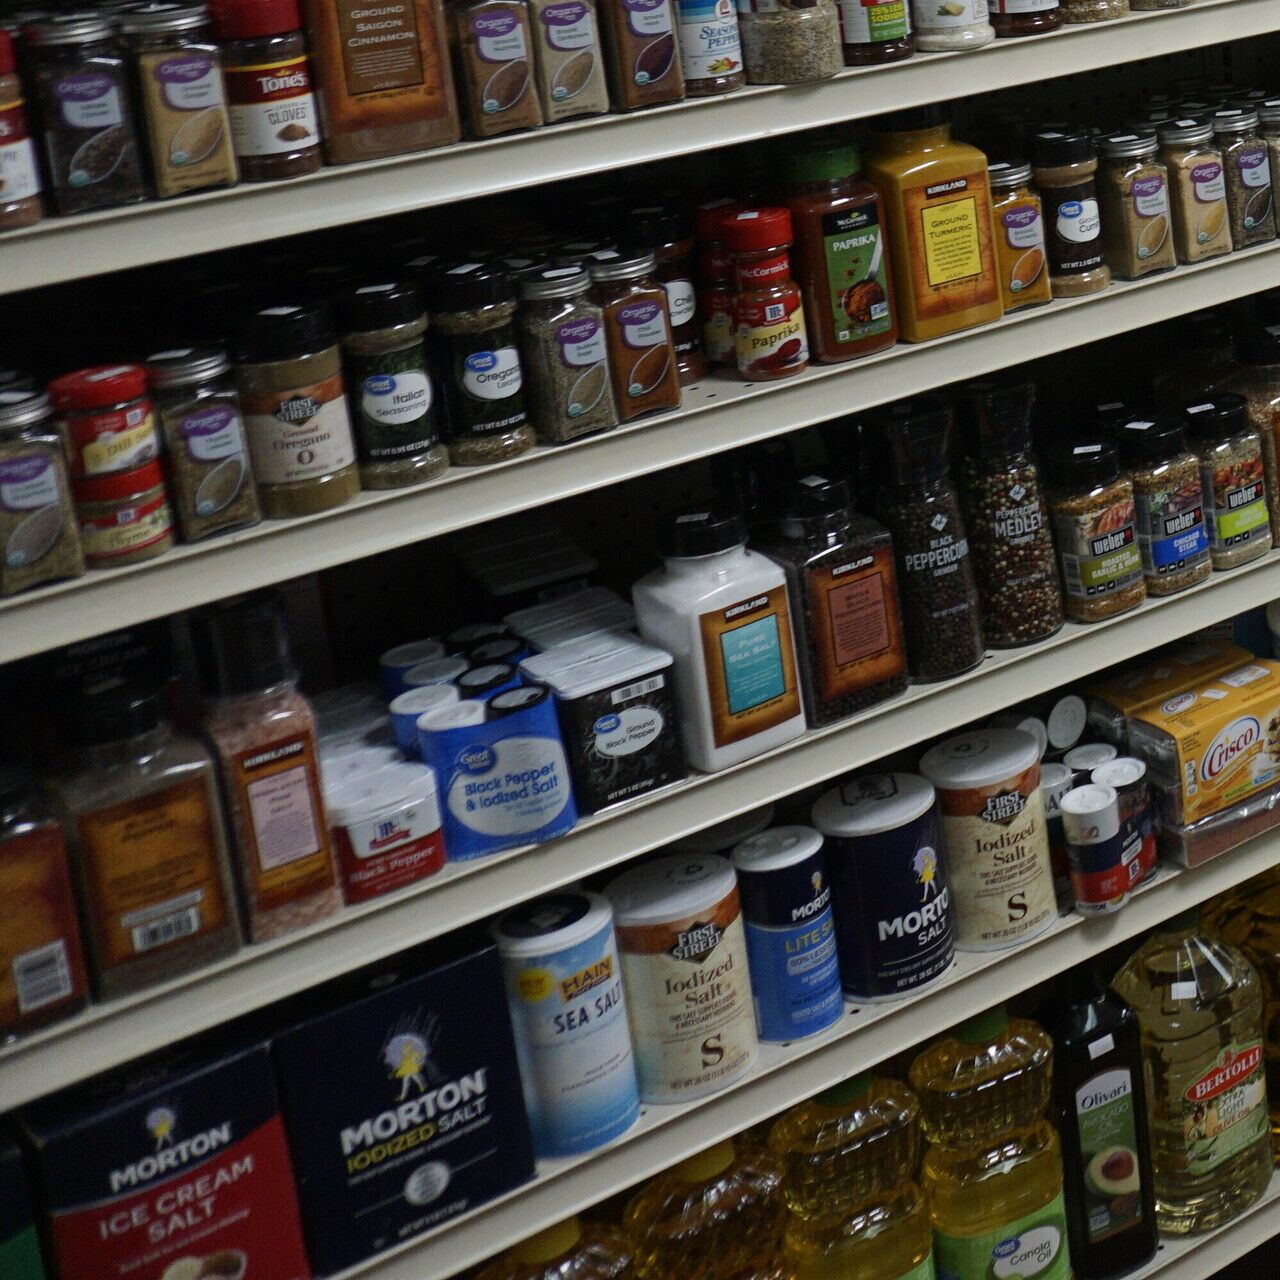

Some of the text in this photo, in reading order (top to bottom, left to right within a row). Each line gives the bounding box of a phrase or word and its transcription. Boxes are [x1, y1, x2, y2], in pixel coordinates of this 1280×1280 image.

[351, 3, 404, 21] GROUND
[348, 30, 414, 48] CINNAMON
[355, 19, 403, 34] SAIGON
[267, 107, 307, 127] CLOVES
[832, 231, 876, 253] PAPRIKA
[928, 223, 976, 240] TURMERIC
[751, 321, 800, 349] Paprika
[391, 387, 426, 405] Italian
[1203, 720, 1261, 780] Crisco
[665, 955, 734, 993] Iodized
[553, 1008, 592, 1035] SEA
[1194, 1047, 1261, 1101] BERTOLLI
[1081, 1080, 1129, 1111] Olivari
[339, 1068, 488, 1154] MORTON
[100, 1156, 254, 1240] ICE CREAM
[146, 1198, 217, 1243] SALT
